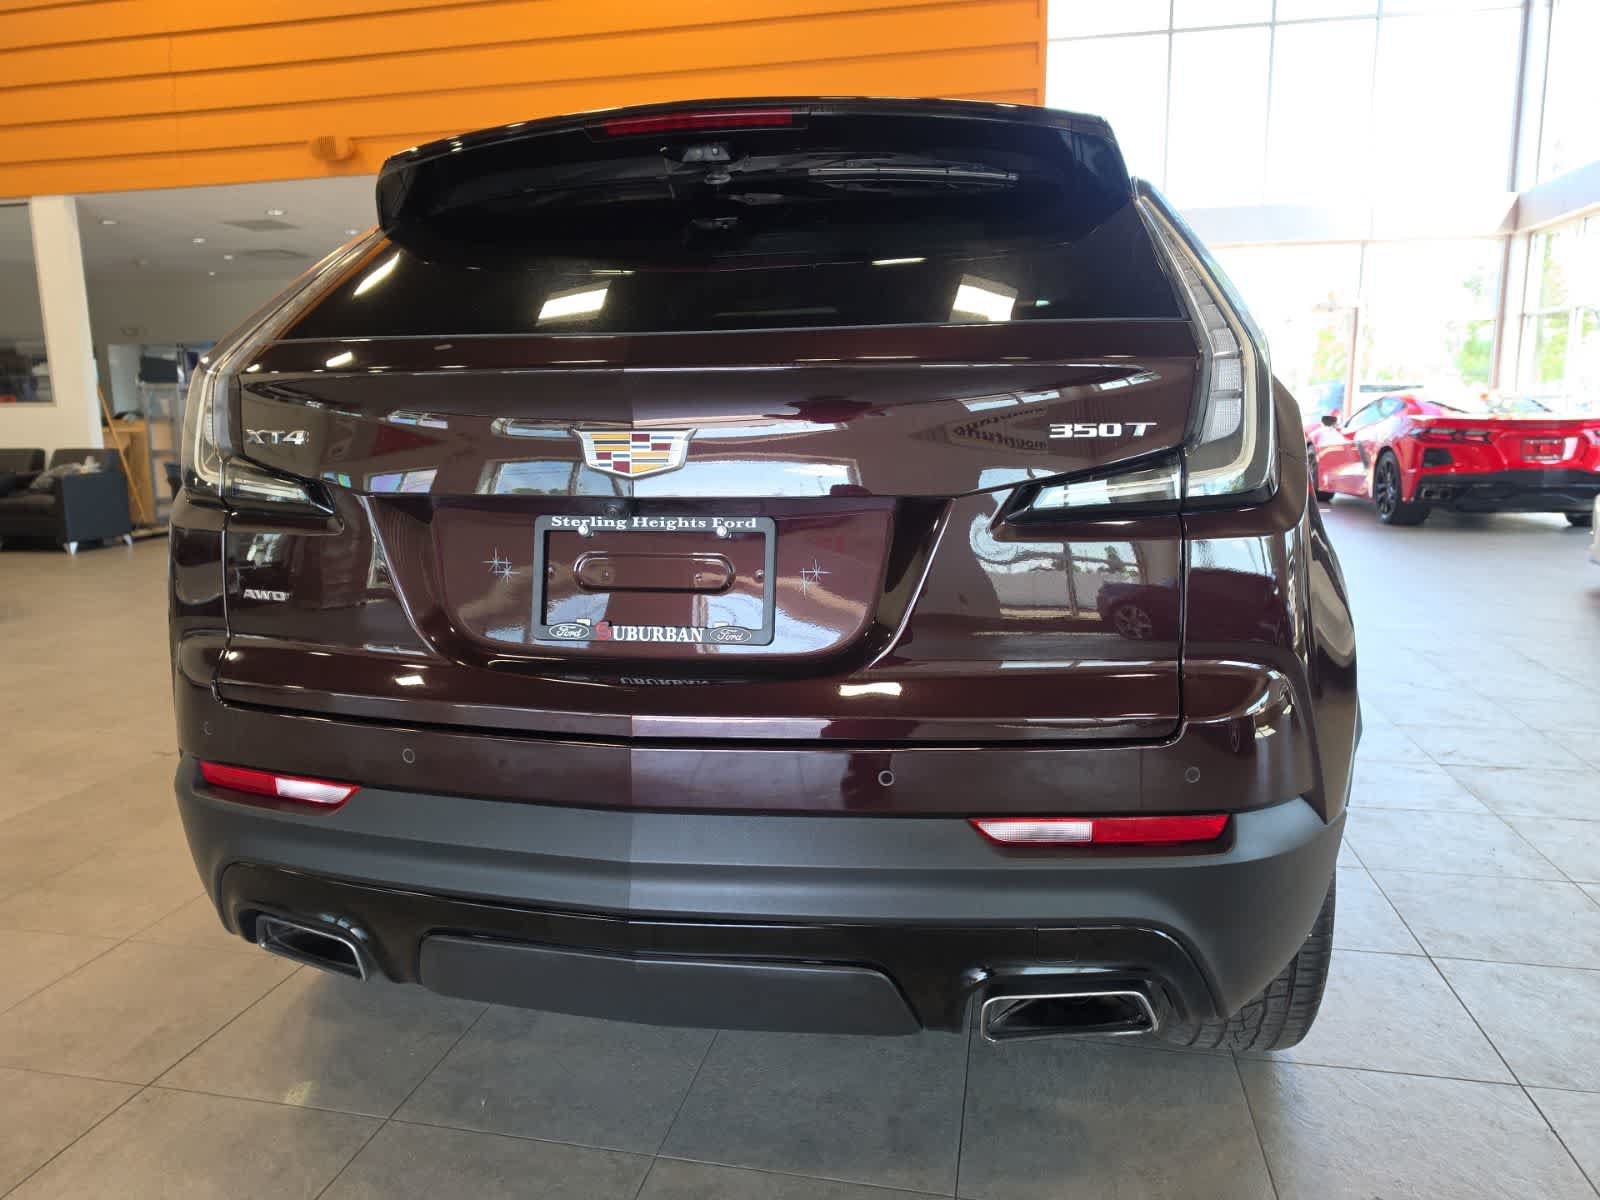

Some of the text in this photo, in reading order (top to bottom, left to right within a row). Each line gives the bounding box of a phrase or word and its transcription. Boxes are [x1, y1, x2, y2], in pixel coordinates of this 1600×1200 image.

[246, 429, 309, 445] XT4
[551, 515, 757, 531] Sterling Heights Ford
[243, 588, 290, 601] AWD
[554, 624, 583, 638] Ford
[595, 620, 705, 642] SUBURBAN
[716, 628, 746, 641] Ford
